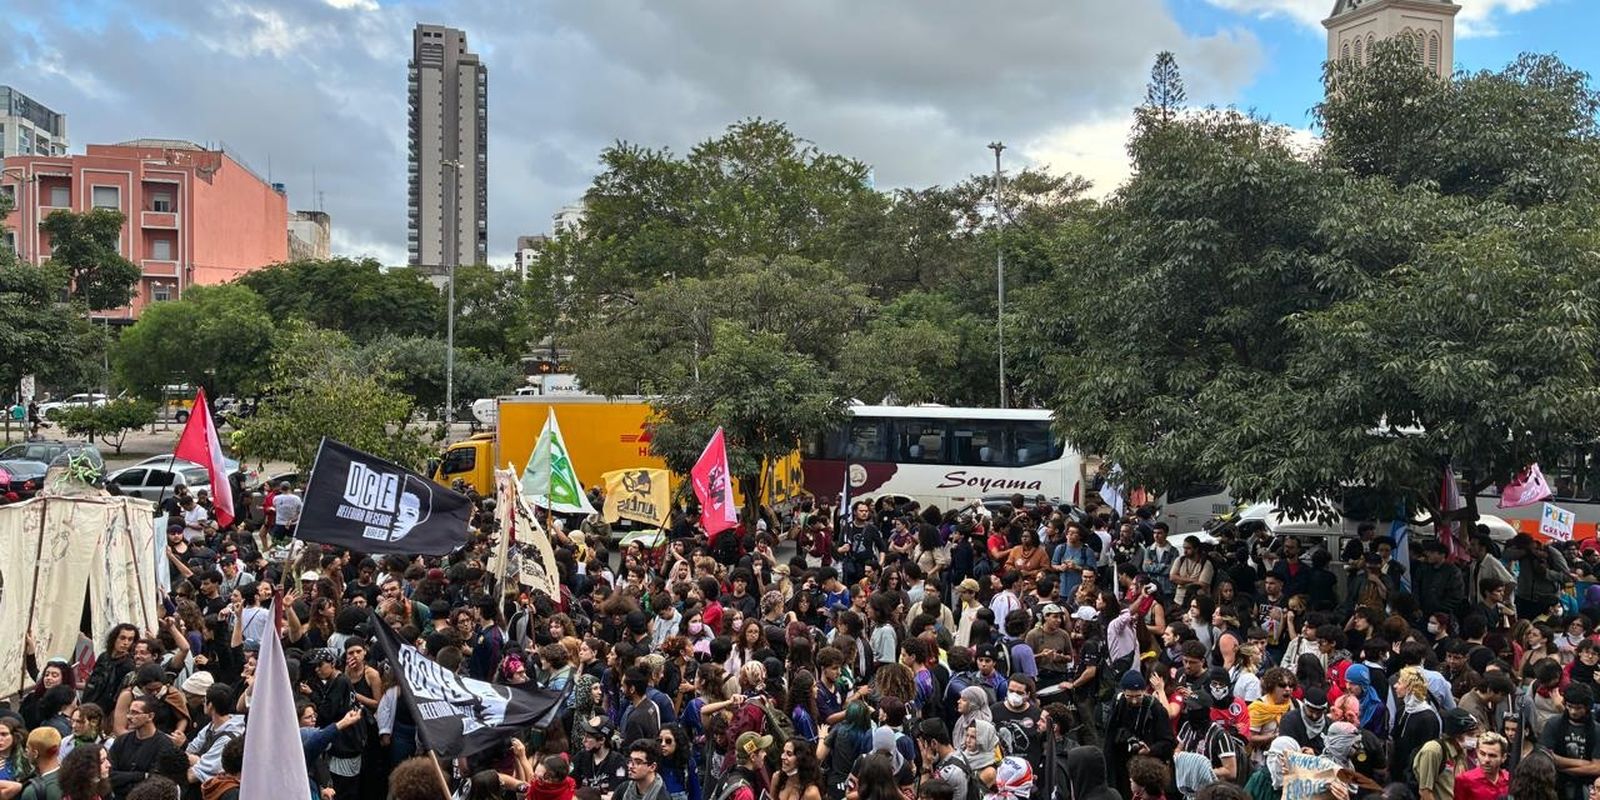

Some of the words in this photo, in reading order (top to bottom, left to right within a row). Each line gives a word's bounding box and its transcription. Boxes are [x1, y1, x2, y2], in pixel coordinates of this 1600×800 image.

[344, 461, 398, 512] DCE
[936, 471, 1042, 493] Soyama
[400, 645, 473, 699] DCE
